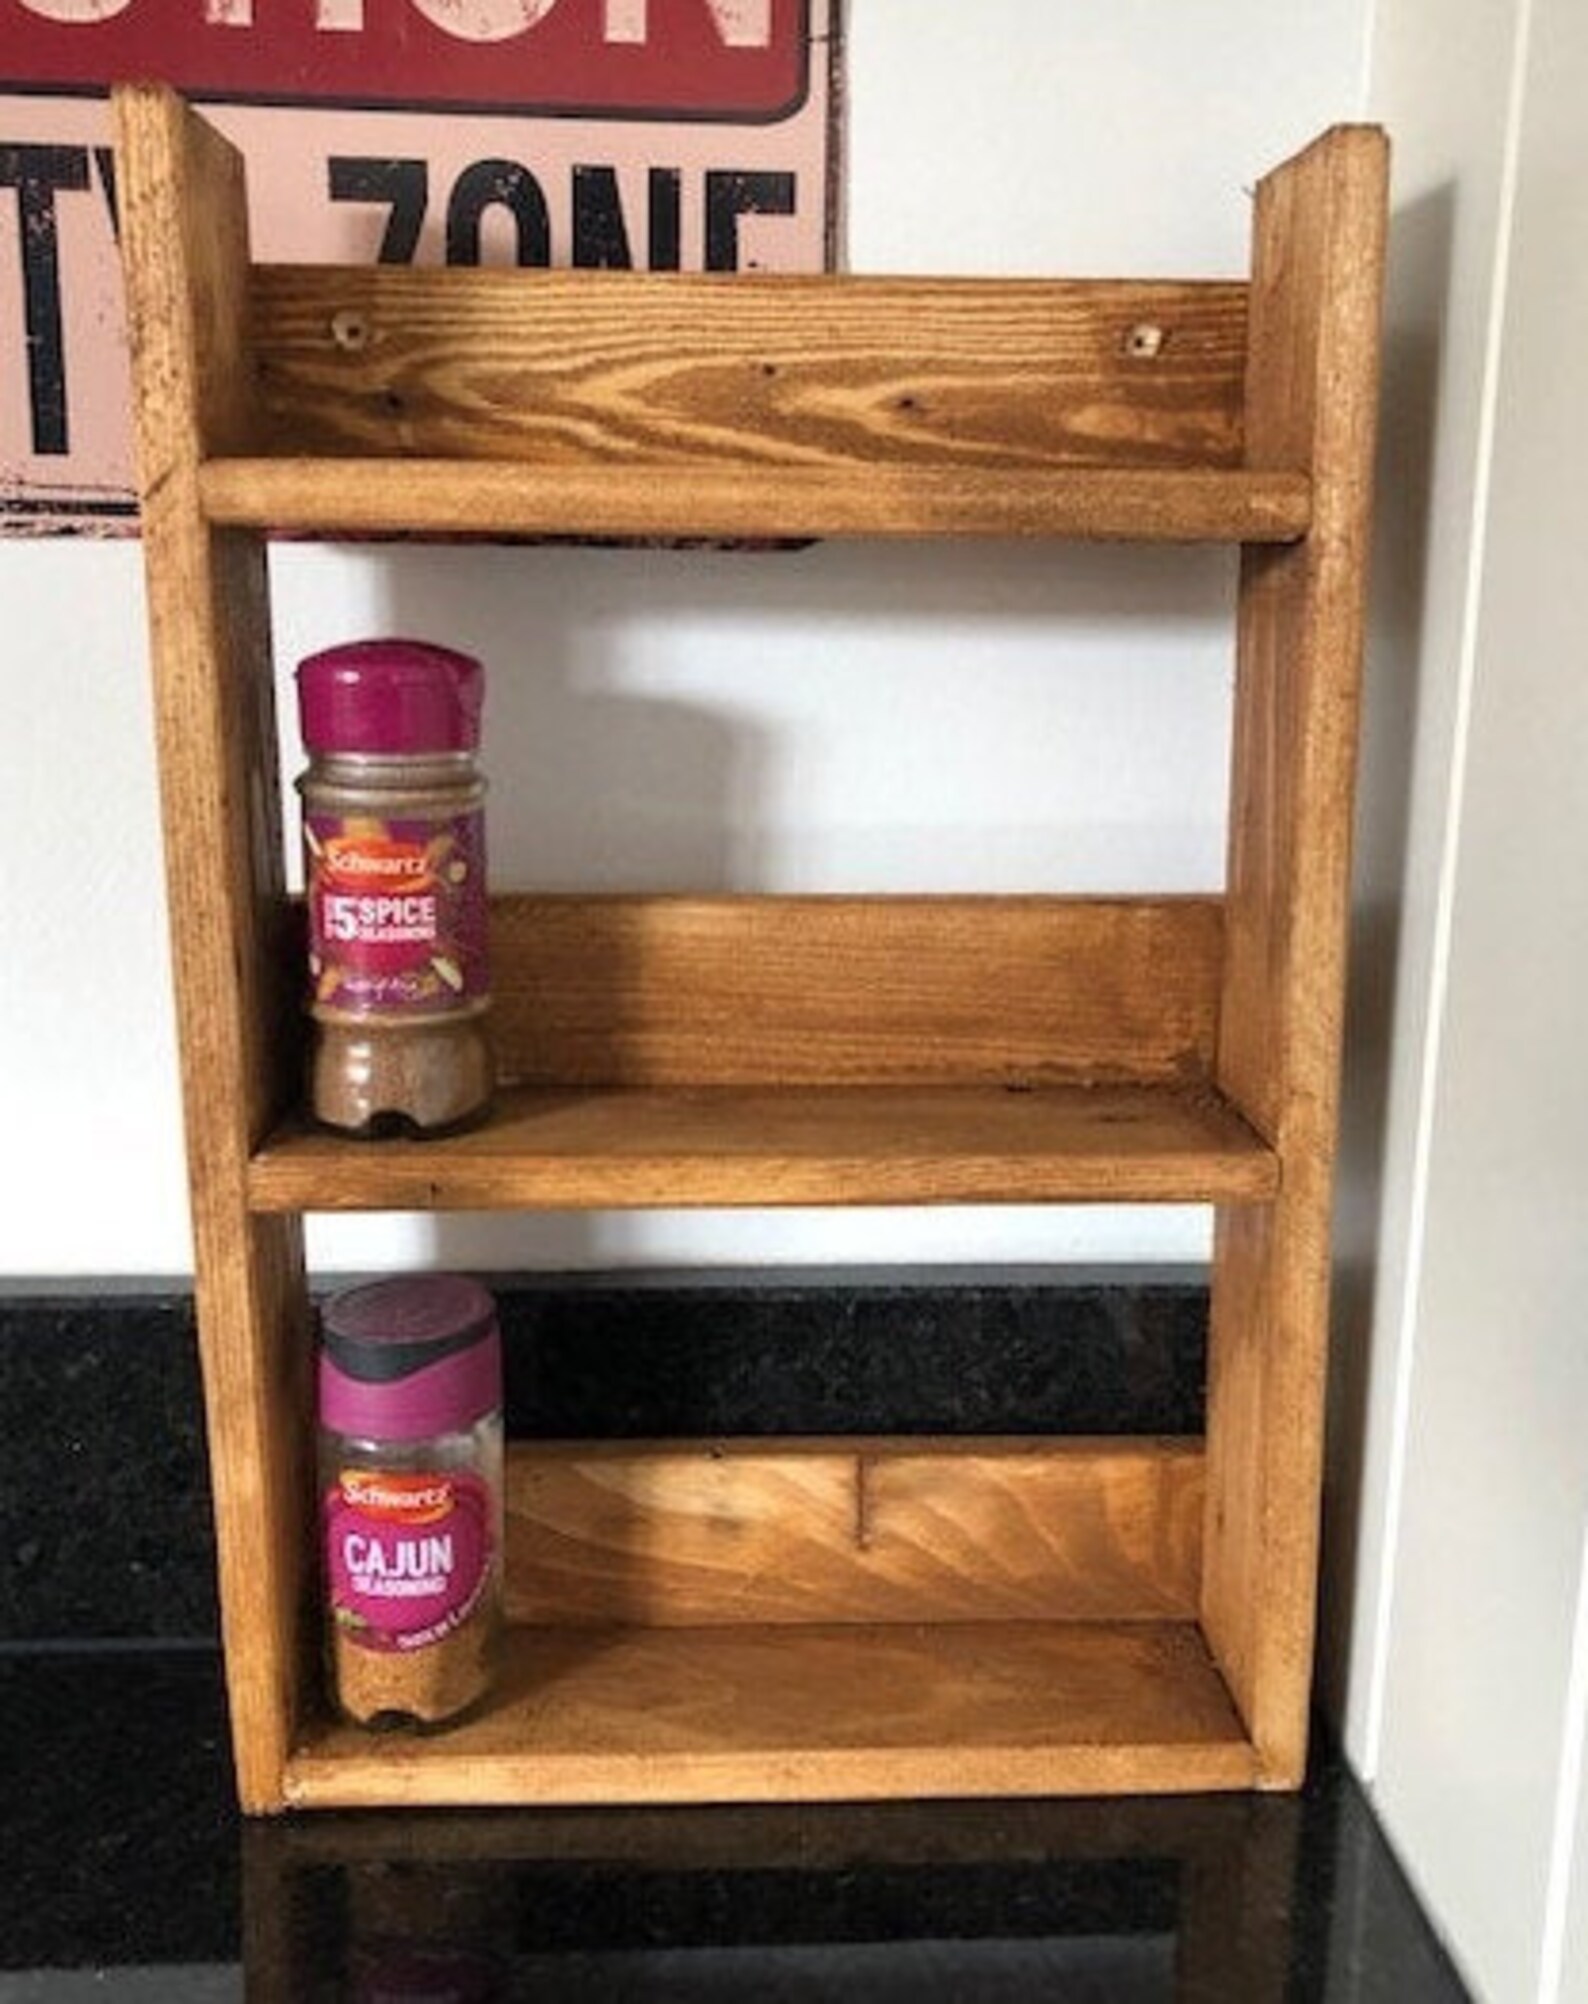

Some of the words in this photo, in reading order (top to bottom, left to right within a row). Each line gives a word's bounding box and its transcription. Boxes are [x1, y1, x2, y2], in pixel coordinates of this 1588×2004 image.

[335, 896, 359, 941] 5
[358, 895, 437, 926] SPICE
[343, 1534, 454, 1578] CAJUN
